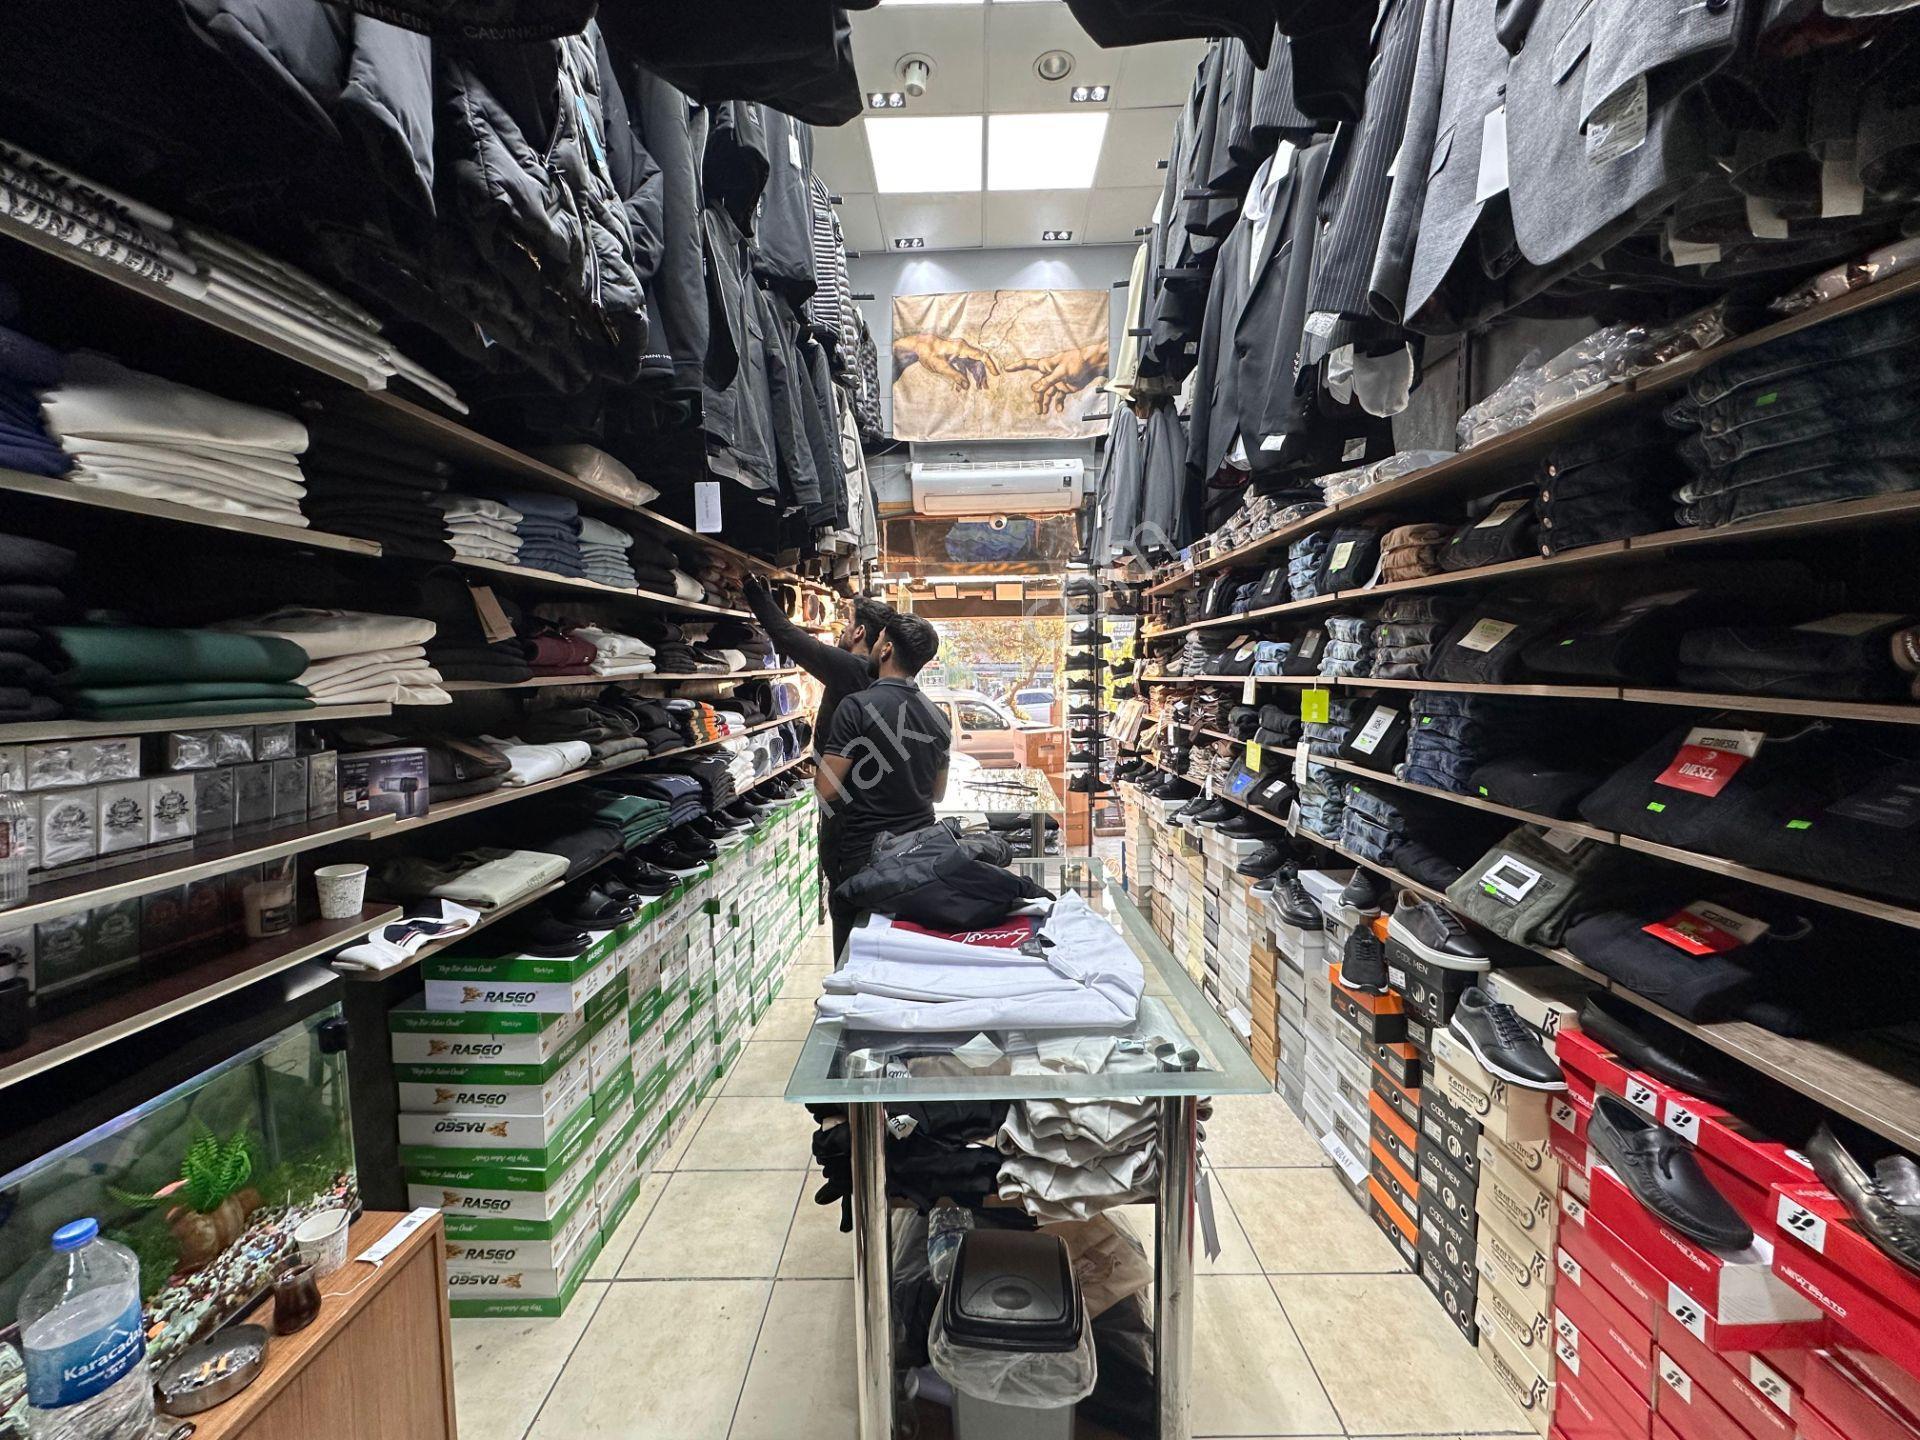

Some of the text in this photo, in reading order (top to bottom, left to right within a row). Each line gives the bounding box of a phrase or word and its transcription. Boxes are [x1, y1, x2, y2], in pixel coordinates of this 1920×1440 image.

[1713, 738, 1740, 750] DIESEL
[1678, 762, 1718, 781] DIESEL
[1412, 959, 1429, 975] MEN
[484, 990, 537, 1004] RASGO
[450, 1042, 504, 1056] RASGO
[456, 1091, 507, 1105] RASGO
[1430, 1102, 1464, 1136] COOL MEN
[434, 1121, 485, 1134] RASGO
[1427, 1151, 1461, 1188] COOL MEN
[462, 1197, 512, 1212] RASGO
[1429, 1206, 1463, 1245] COOL MEN
[465, 1248, 517, 1262] RASGO
[1427, 1250, 1459, 1293] COOL MEN
[449, 1273, 500, 1286] RASGO
[1780, 1264, 1848, 1318] NEW PRATO
